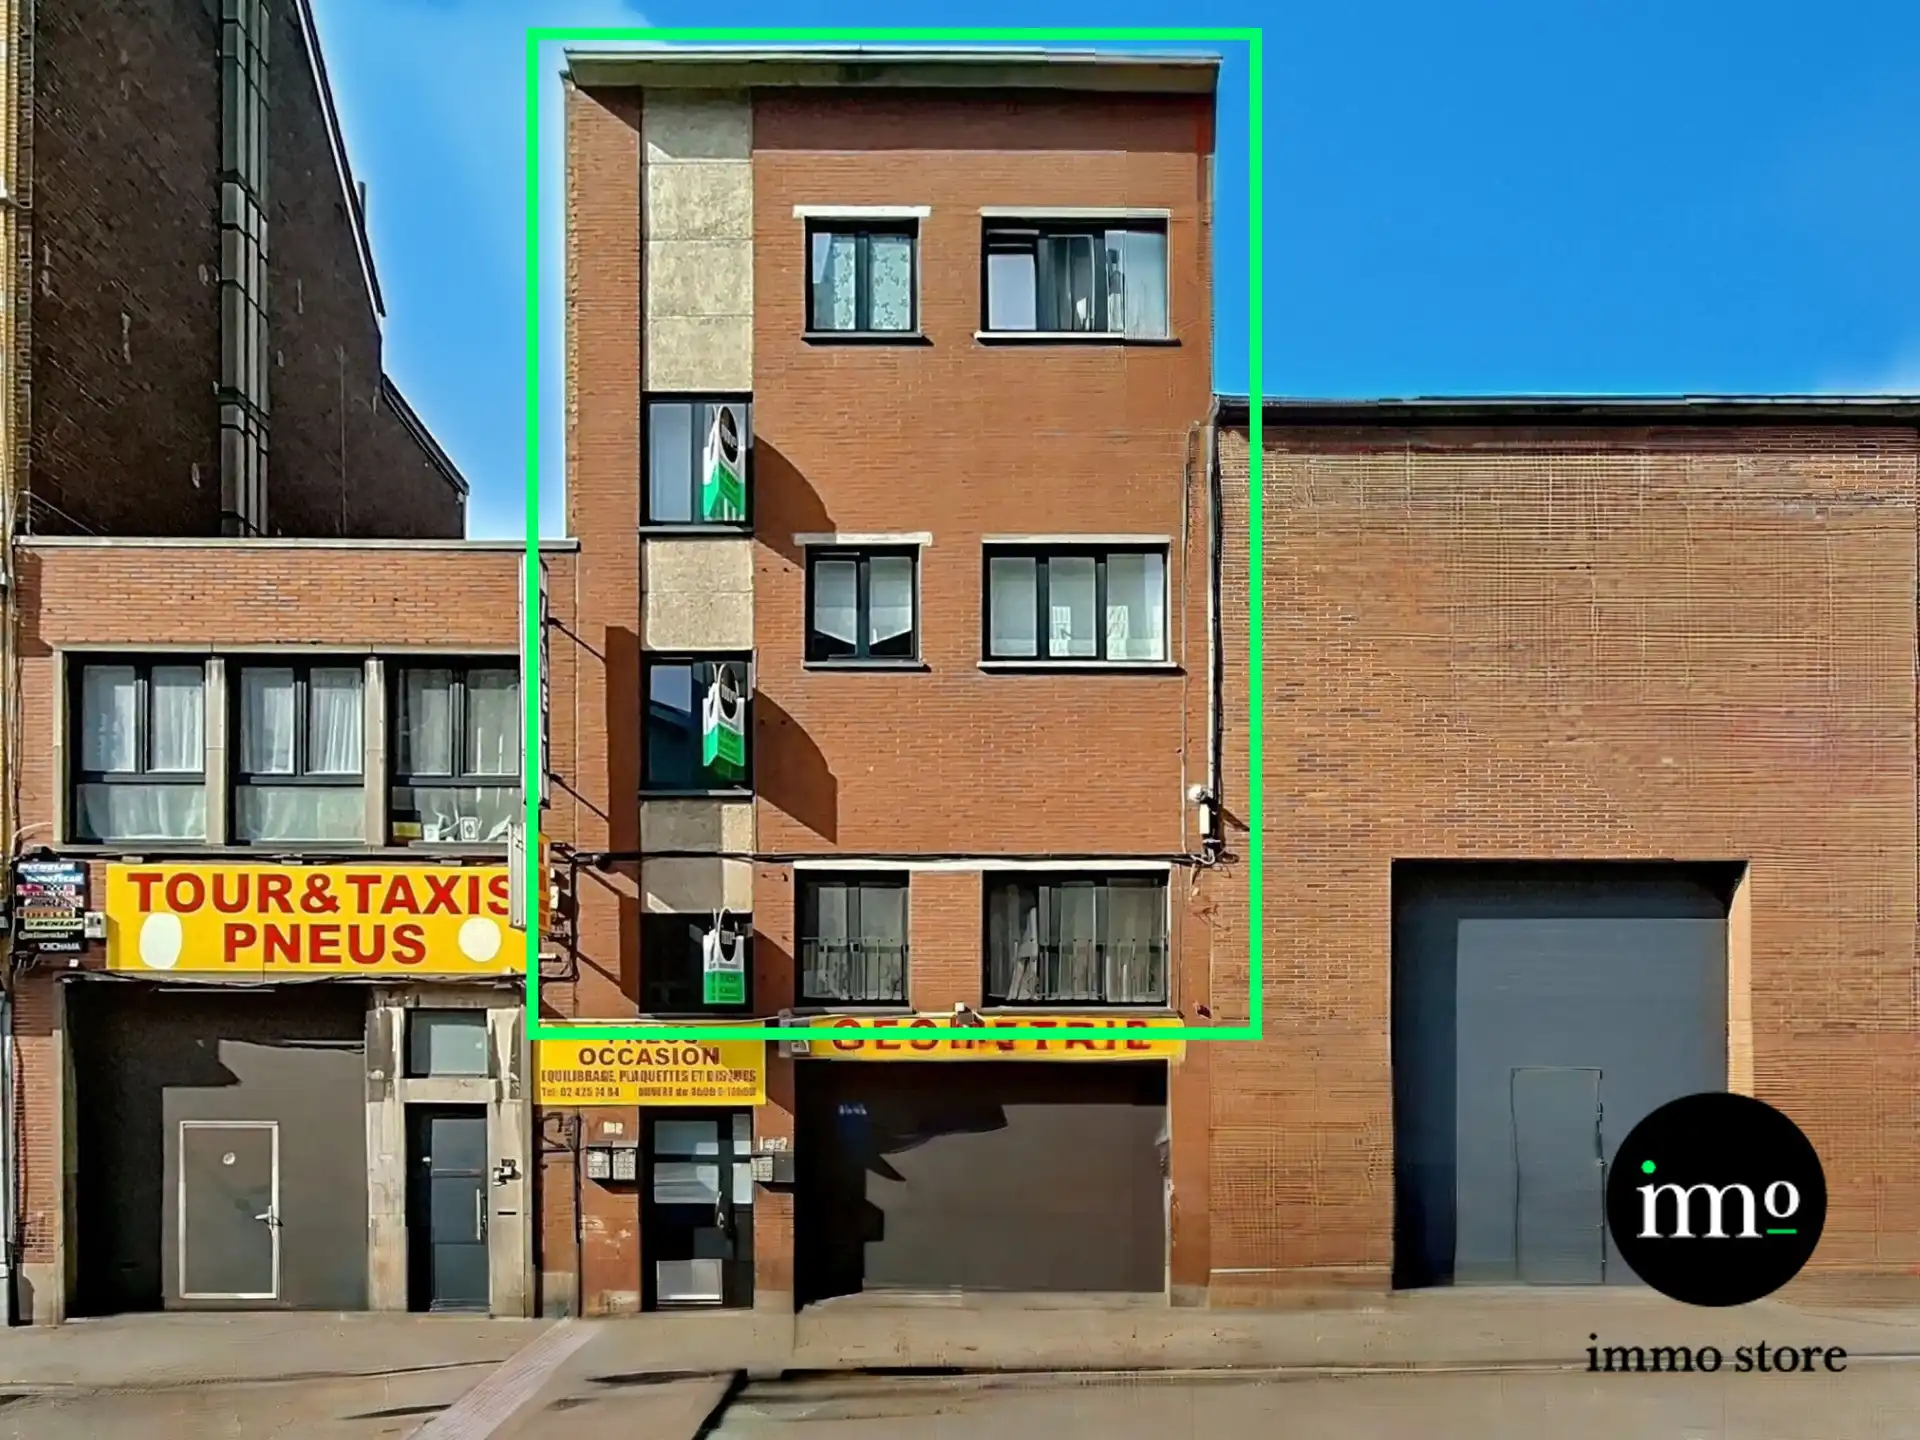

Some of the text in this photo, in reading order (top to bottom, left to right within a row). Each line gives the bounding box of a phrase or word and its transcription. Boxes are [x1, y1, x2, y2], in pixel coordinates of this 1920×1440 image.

[223, 923, 426, 964] PNEUS
[578, 1047, 720, 1065] OCCASION
[691, 1070, 704, 1082] ET
[560, 1087, 572, 1096] 02
